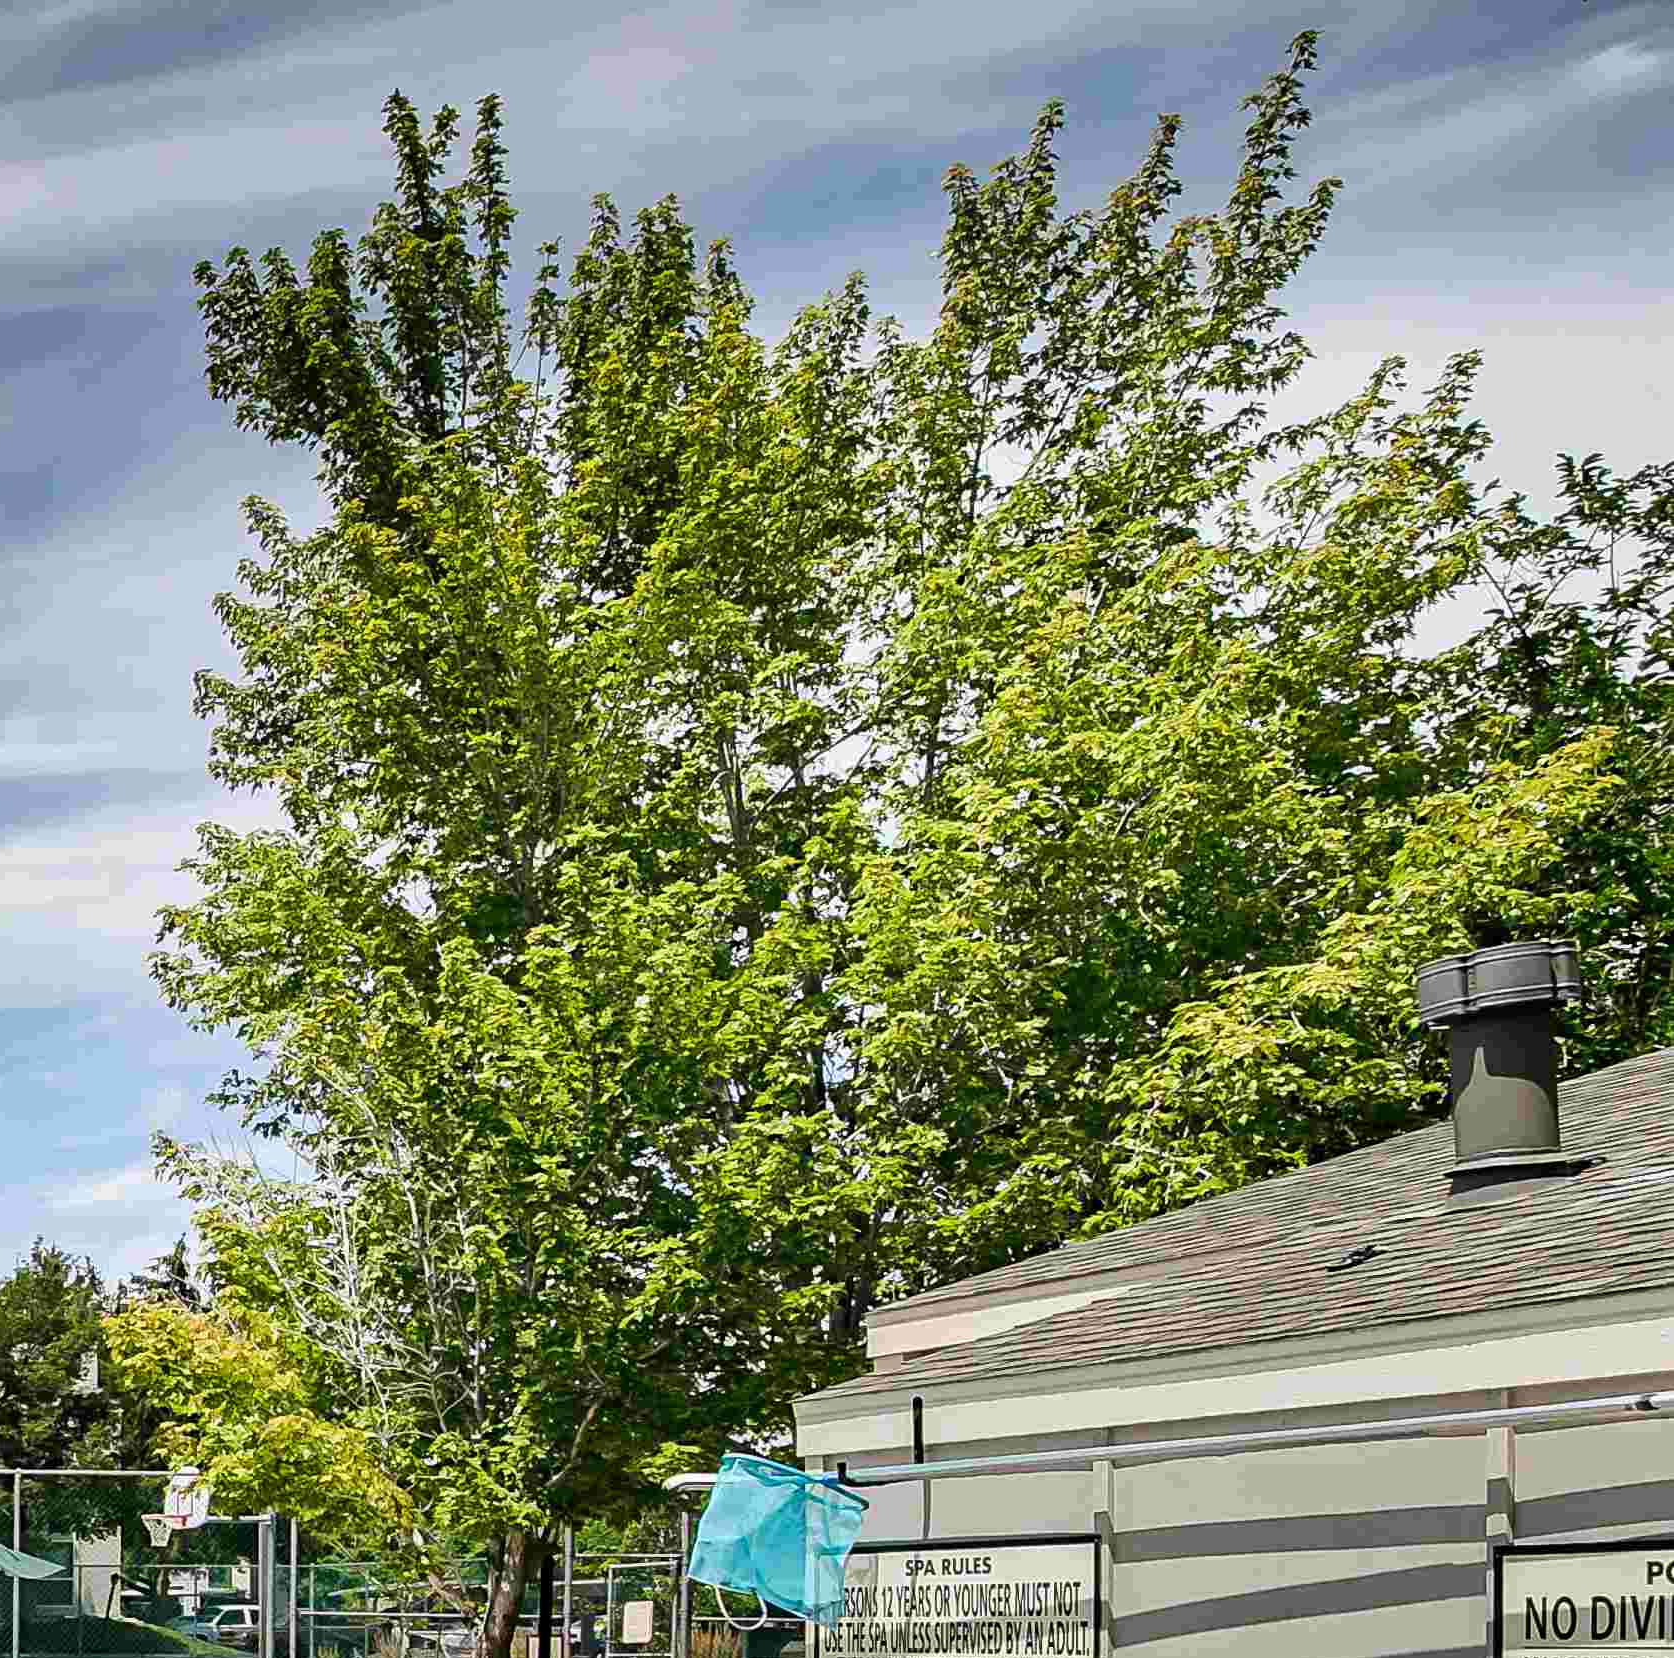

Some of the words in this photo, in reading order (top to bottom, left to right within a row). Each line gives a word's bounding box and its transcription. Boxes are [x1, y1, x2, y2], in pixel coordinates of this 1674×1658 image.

[905, 1559, 935, 1576] SPA
[941, 1557, 991, 1575] RULES
[844, 1586, 877, 1617] RSONS
[882, 1586, 893, 1617] 12
[896, 1585, 932, 1617] YEARS
[934, 1585, 951, 1617] OR
[954, 1583, 1012, 1617] YOUNGER
[1015, 1582, 1050, 1617] MUST
[1054, 1582, 1081, 1617] NOT
[1525, 1596, 1577, 1641] NO
[1591, 1595, 1674, 1641] DIVI
[846, 1622, 865, 1652] THE
[868, 1622, 888, 1653] SPA
[891, 1622, 932, 1653] UNLESS
[934, 1621, 1003, 1655] SUPERVISED
[1006, 1621, 1022, 1655] BY
[1025, 1621, 1044, 1655] AN
